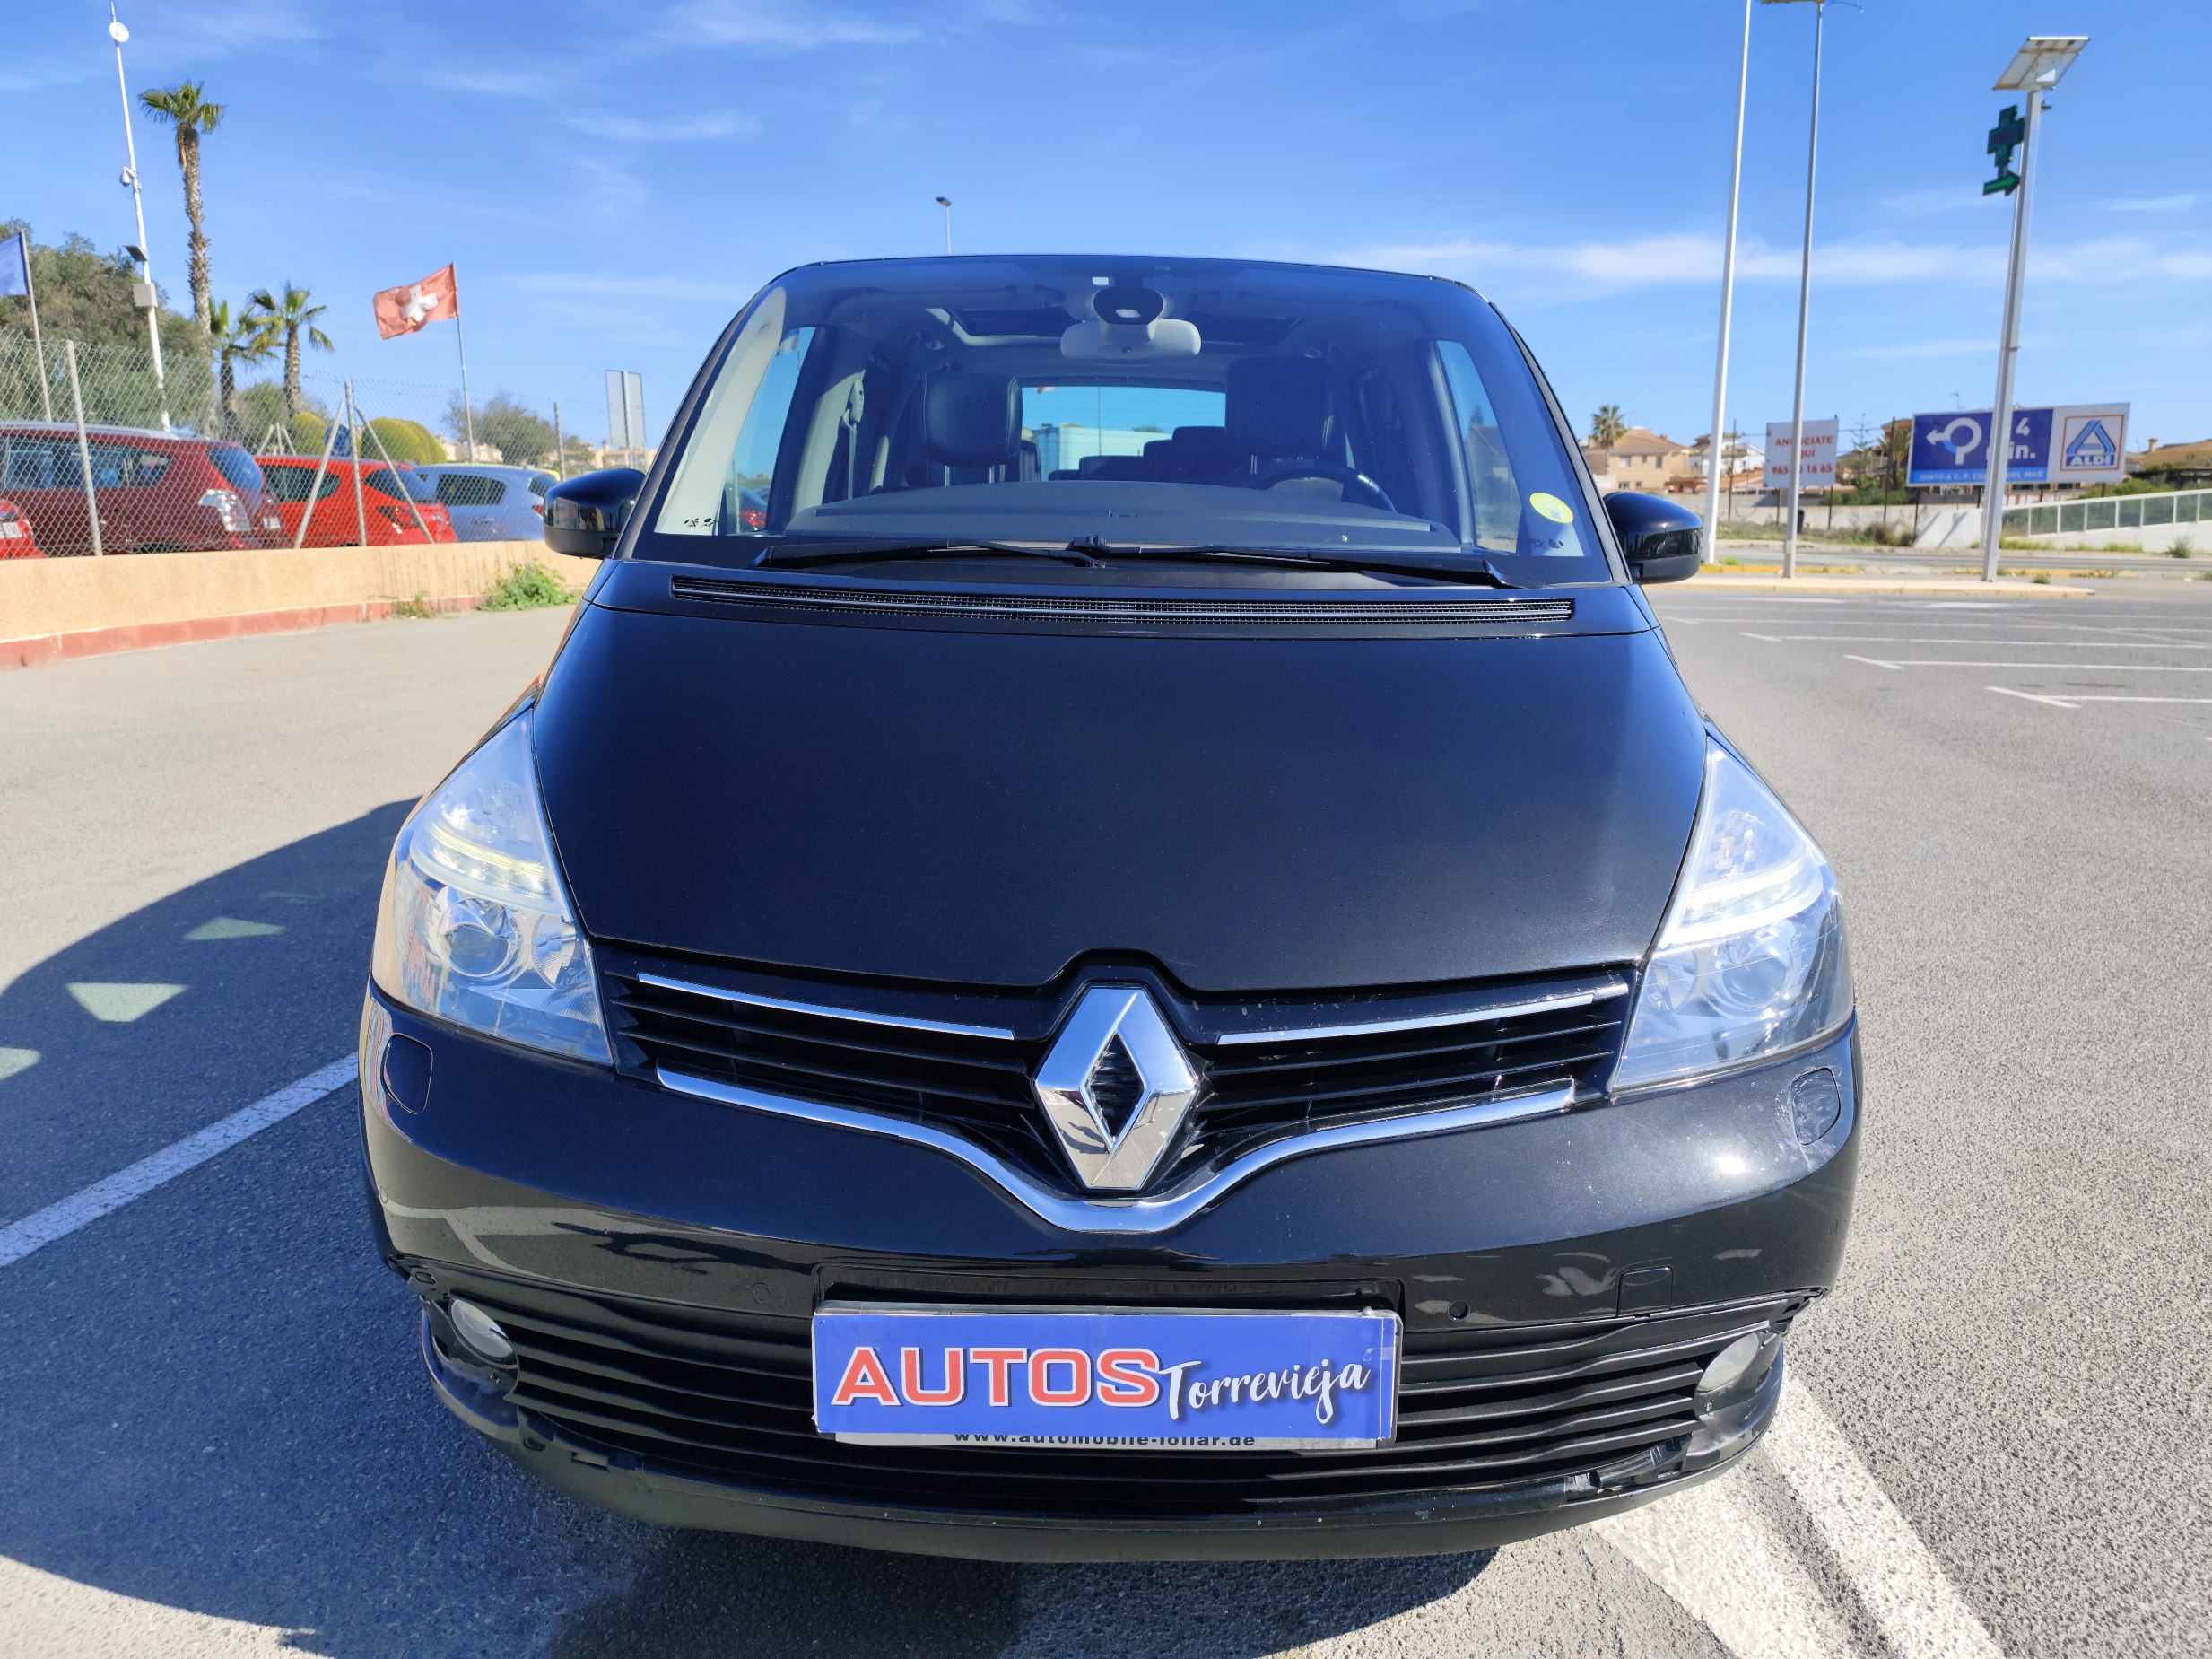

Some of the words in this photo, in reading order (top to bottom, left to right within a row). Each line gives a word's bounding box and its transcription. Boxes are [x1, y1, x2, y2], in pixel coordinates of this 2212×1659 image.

[2016, 417, 2030, 436] 4
[2068, 454, 2113, 467] ALDI
[1772, 465, 1789, 475] 965
[1807, 464, 1817, 474] 16
[1820, 463, 1833, 474] 65
[831, 1346, 1161, 1408] AUTOS
[1157, 1358, 1372, 1425] Torrevieja
